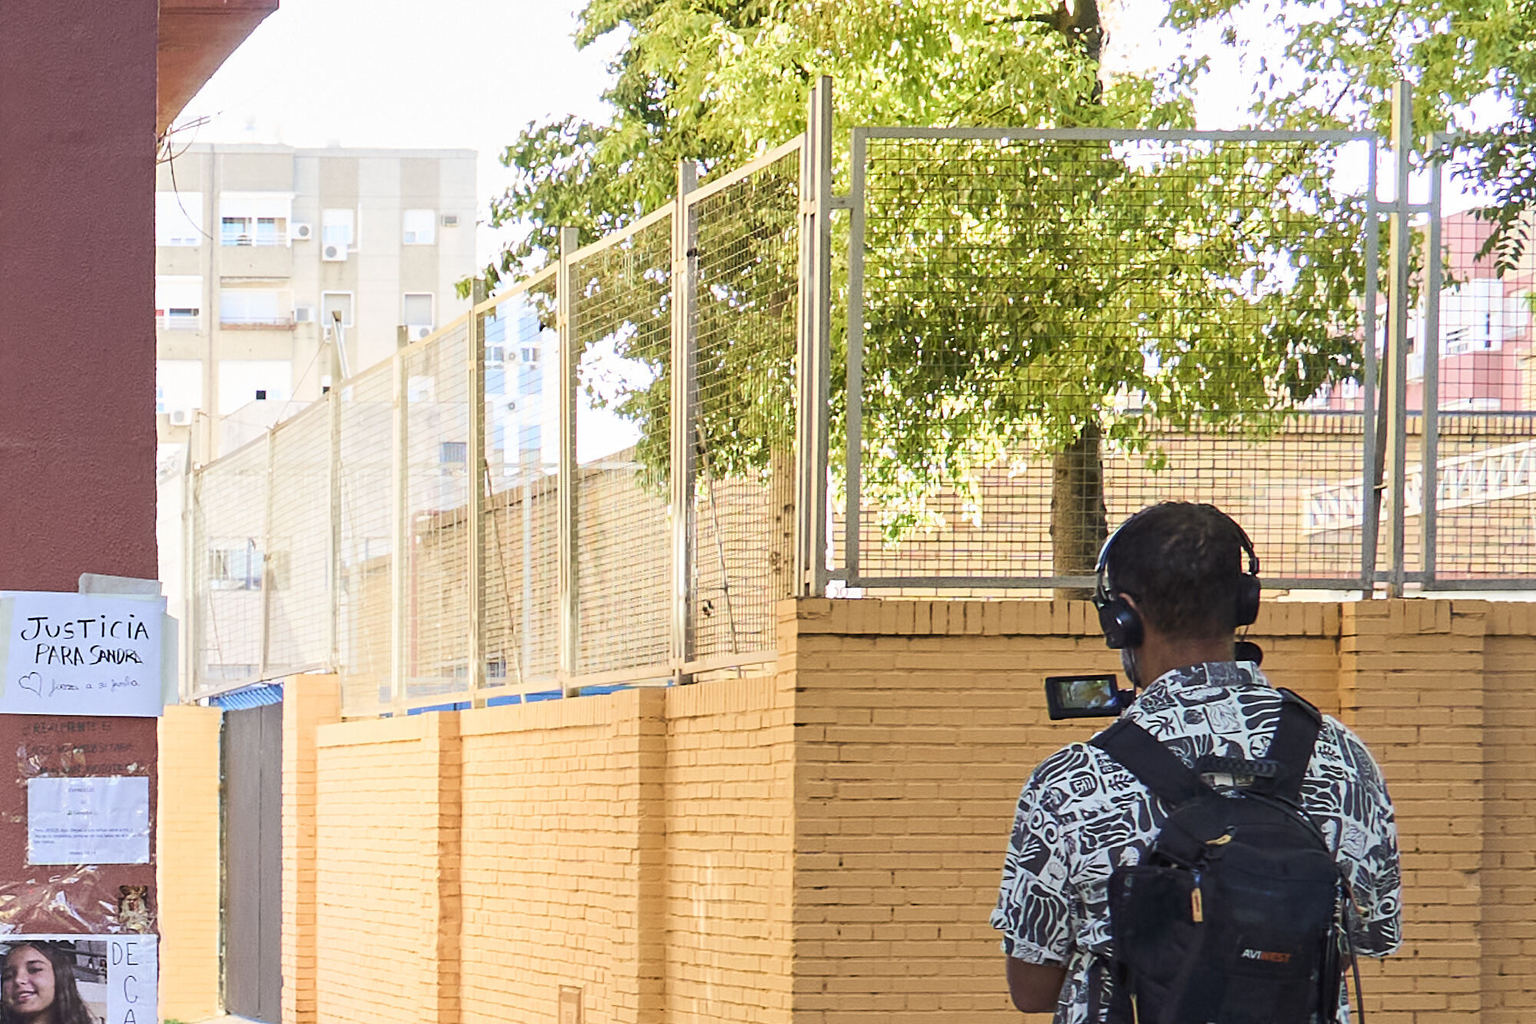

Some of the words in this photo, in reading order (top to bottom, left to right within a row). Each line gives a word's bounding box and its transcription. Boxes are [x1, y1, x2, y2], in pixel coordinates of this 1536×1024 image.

[21, 614, 149, 641] JUSTICIA
[35, 643, 85, 666] PARA
[89, 644, 144, 666] SANDRA
